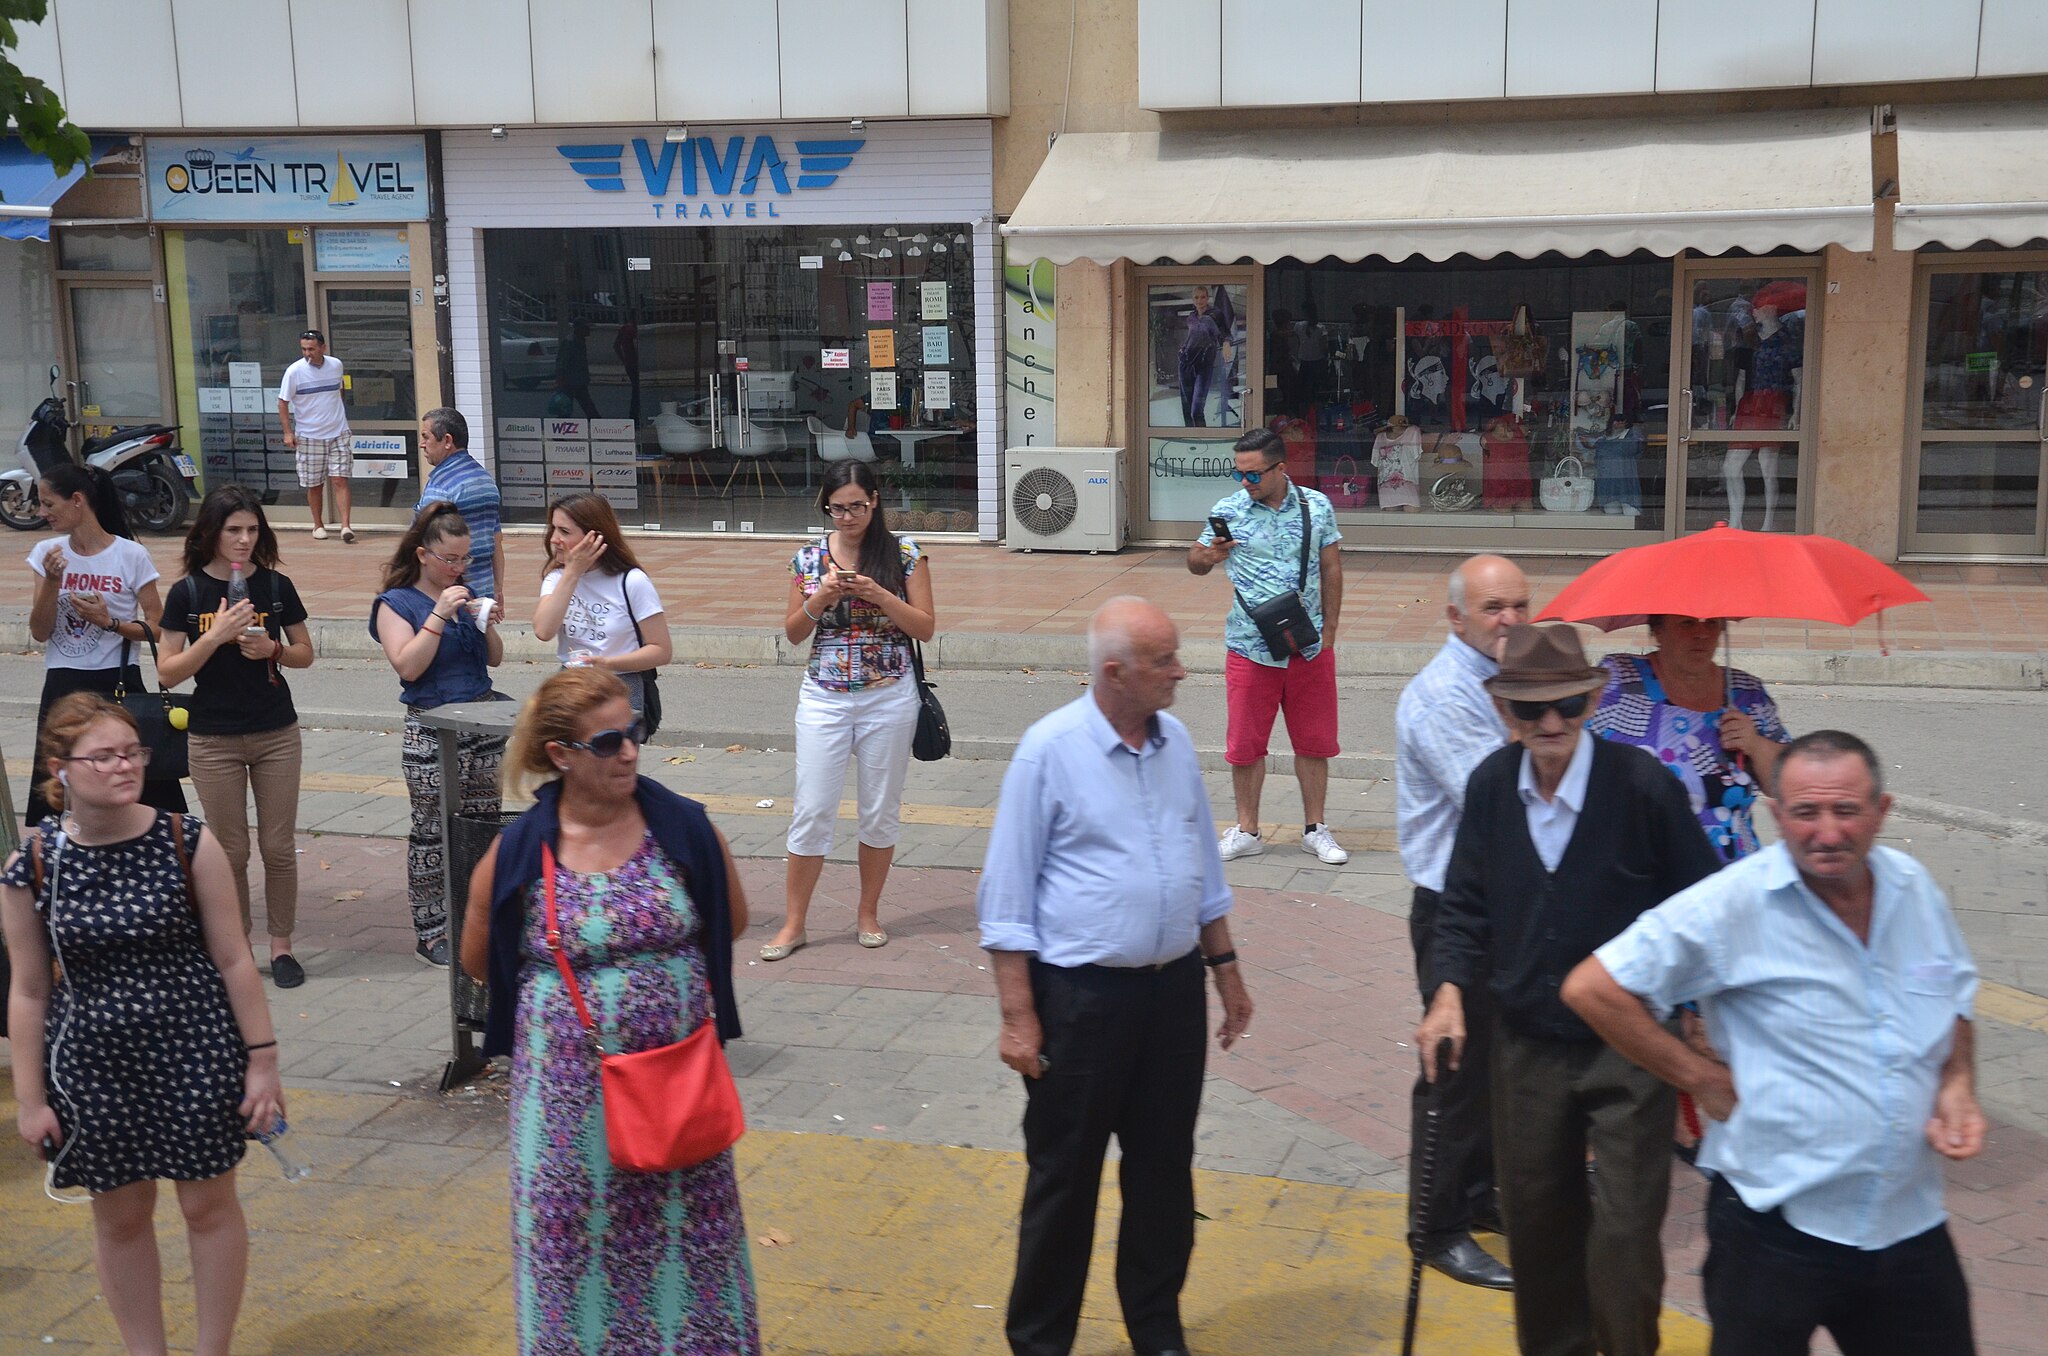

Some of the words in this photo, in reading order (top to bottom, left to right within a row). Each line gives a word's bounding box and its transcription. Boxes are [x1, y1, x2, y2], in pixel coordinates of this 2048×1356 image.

[632, 136, 791, 196] VIVA
[165, 162, 276, 194] QUEEN
[370, 193, 390, 201] TRAVEL
[391, 193, 415, 201] AGENCY
[653, 202, 779, 218] TRAVEL
[303, 225, 309, 236] 5
[628, 258, 633, 269] 6
[155, 288, 163, 298] 4
[1830, 282, 1838, 293] 7
[415, 290, 421, 302] 5
[505, 424, 535, 432] Alitalia
[552, 422, 579, 435] WIZZ
[593, 426, 622, 434] Austrian
[355, 440, 400, 449] Adriatica
[207, 456, 228, 466] WIZZ
[1154, 457, 1186, 478] CITY
[1088, 477, 1108, 485] AUX
[851, 608, 884, 616] BEYO
